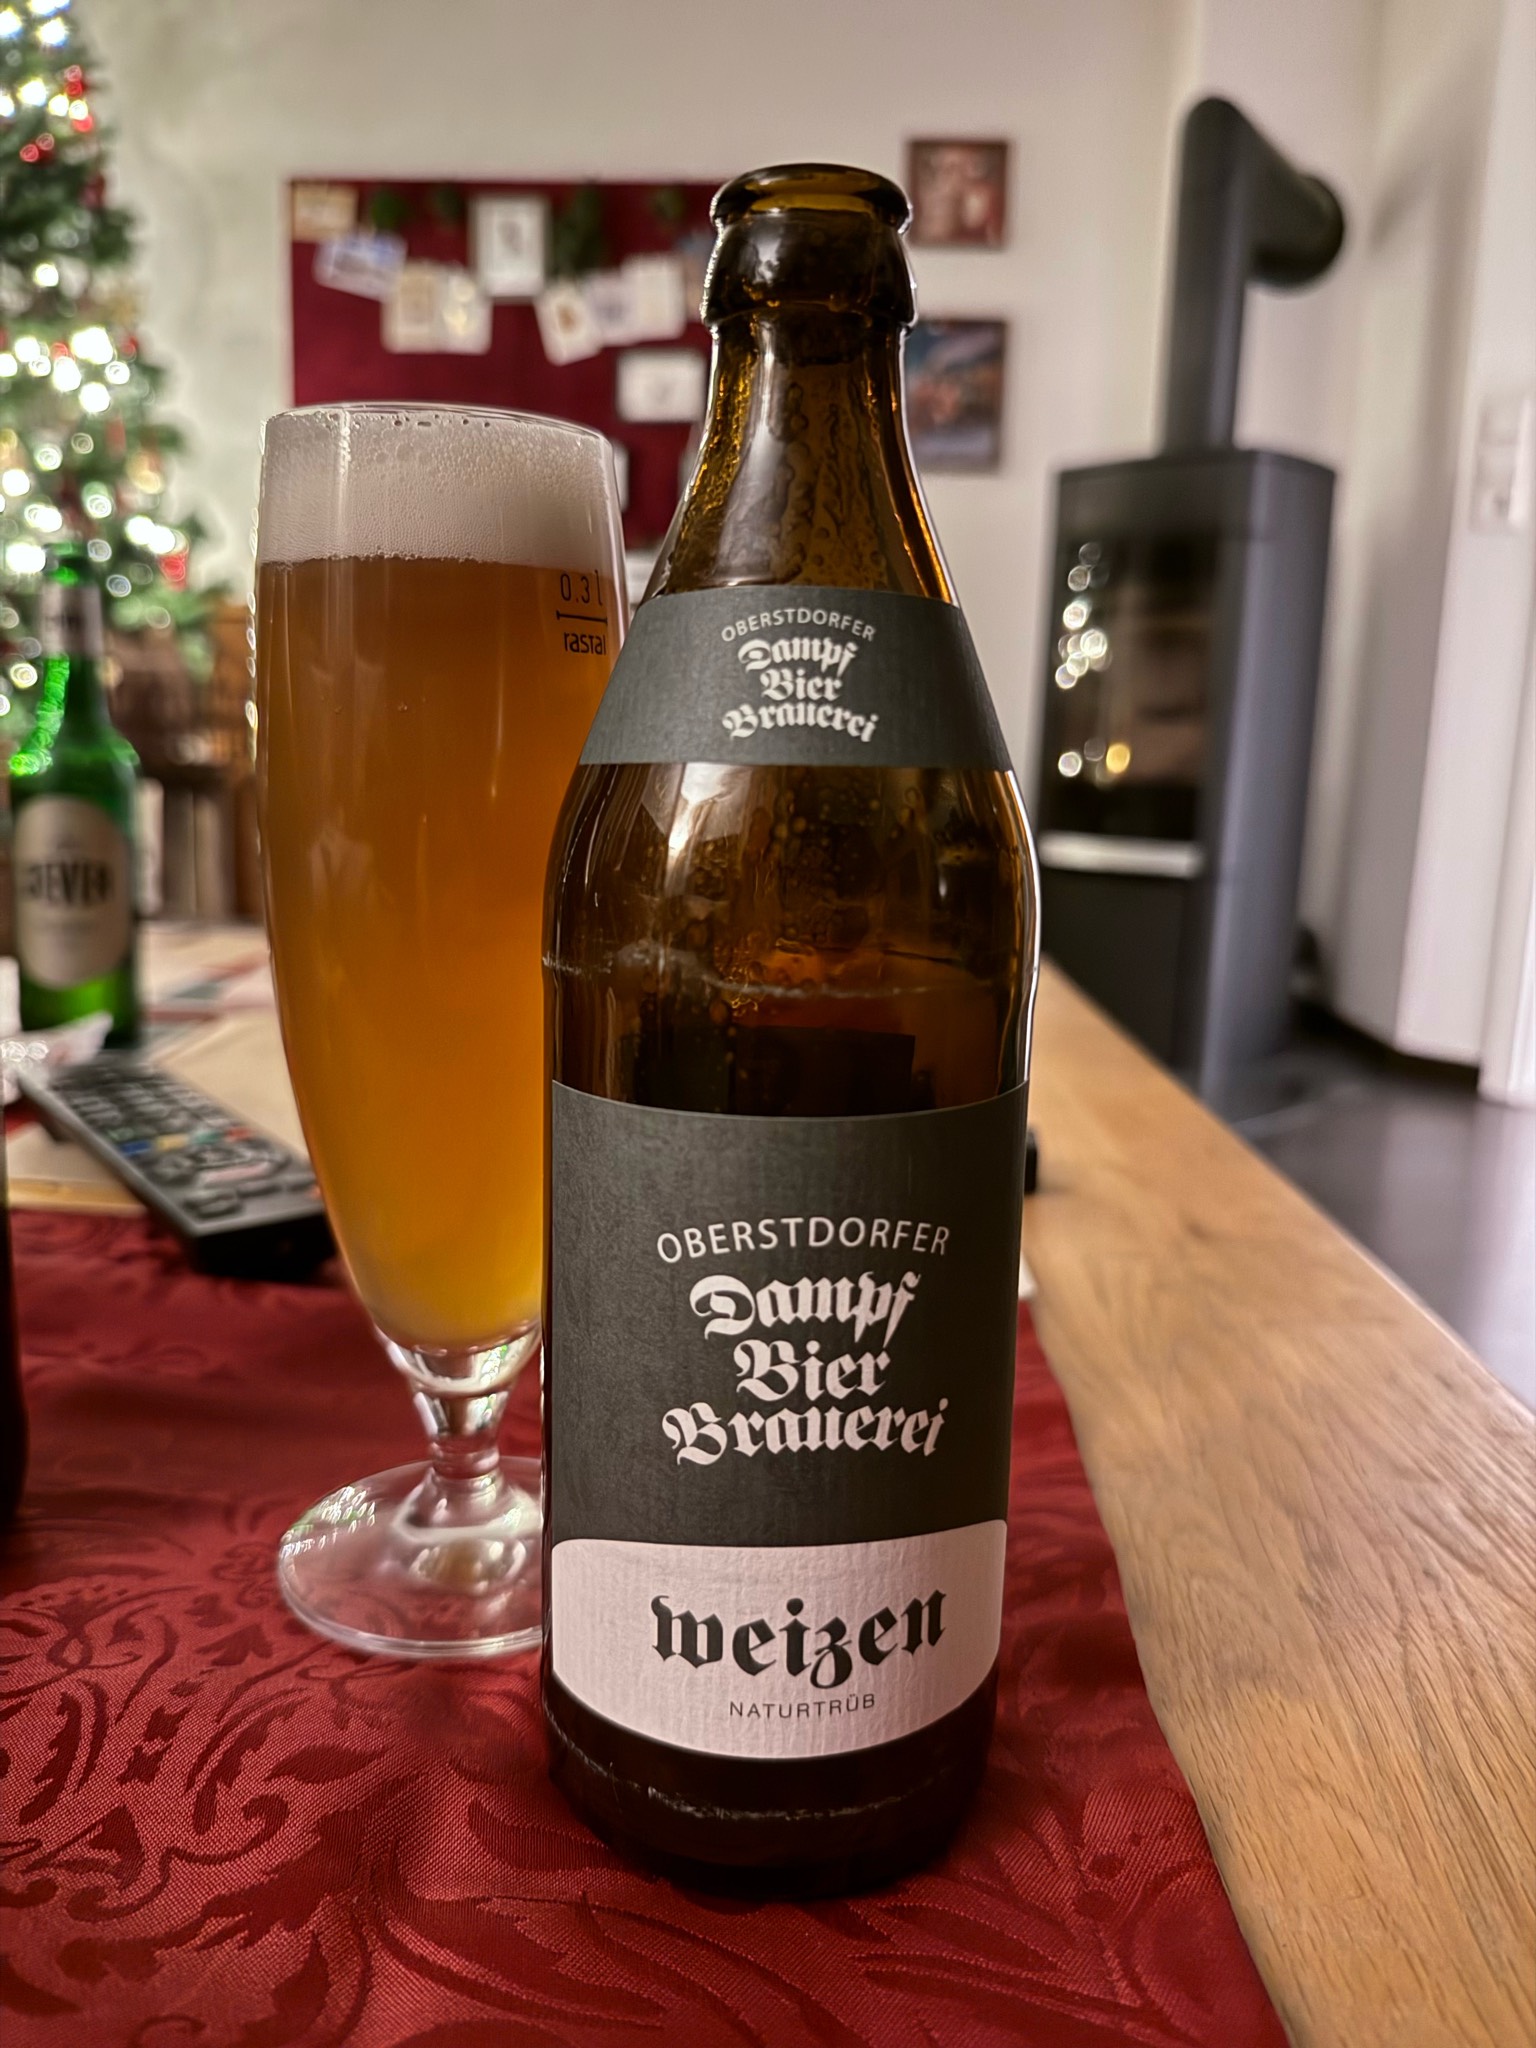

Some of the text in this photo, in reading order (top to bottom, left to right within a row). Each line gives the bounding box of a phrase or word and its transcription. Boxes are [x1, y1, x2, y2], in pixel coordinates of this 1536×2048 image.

[563, 632, 607, 656] rastal
[721, 608, 876, 642] OBERSTDORFER
[737, 637, 859, 678] Dampf
[760, 668, 843, 701] Bier
[721, 702, 880, 743] Brauerei
[657, 1216, 950, 1263] OBERSTDORFER
[689, 1271, 921, 1349] Dampf
[733, 1339, 891, 1401] Bier
[661, 1398, 949, 1466] Brauerei
[650, 1589, 947, 1690] weizen
[729, 1693, 876, 1719] NATURTRÜB
